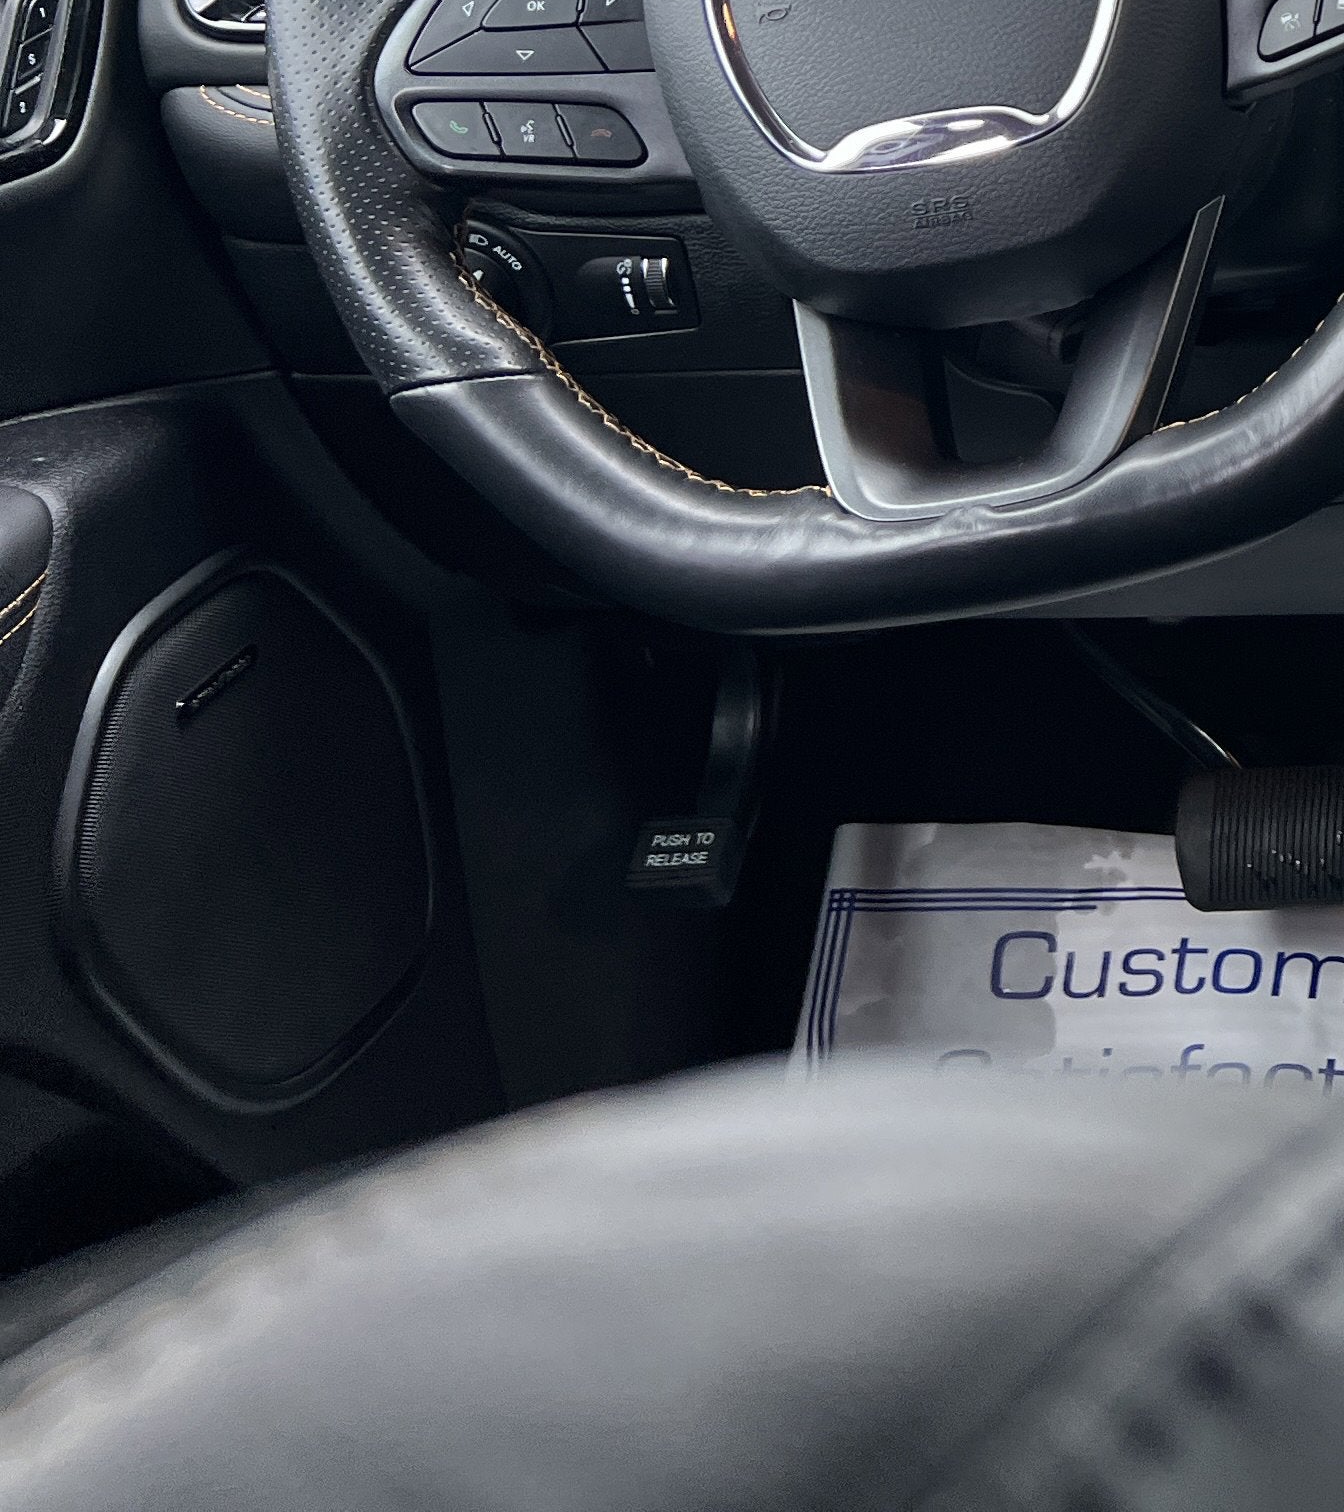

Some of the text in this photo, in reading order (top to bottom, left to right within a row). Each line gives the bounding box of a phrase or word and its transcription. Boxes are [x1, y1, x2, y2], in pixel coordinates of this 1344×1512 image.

[527, 0, 545, 12] OK
[39, 7, 46, 18] 1
[28, 53, 36, 65] S
[523, 132, 536, 144] VR
[492, 243, 523, 272] AUTO
[651, 832, 715, 847] PUSH TO
[645, 851, 709, 866] RELEASE
